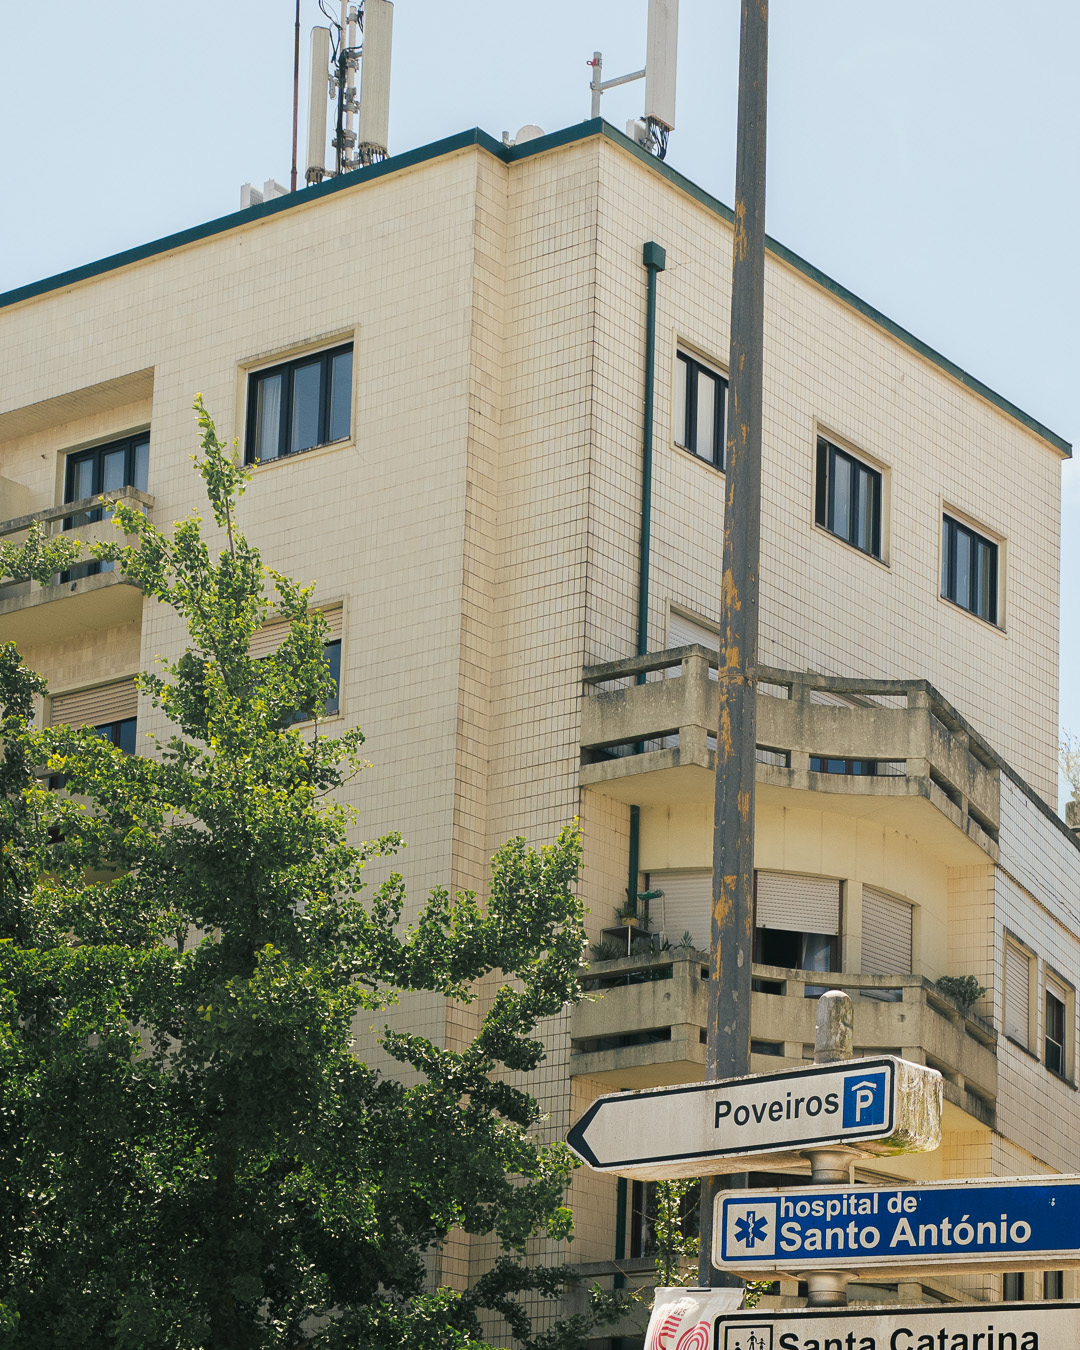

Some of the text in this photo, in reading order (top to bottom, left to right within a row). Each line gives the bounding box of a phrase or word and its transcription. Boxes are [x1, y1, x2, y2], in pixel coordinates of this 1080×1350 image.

[712, 1092, 840, 1129] Poveiros
[779, 1191, 918, 1219] hospital de
[779, 1213, 1033, 1252] Santo António
